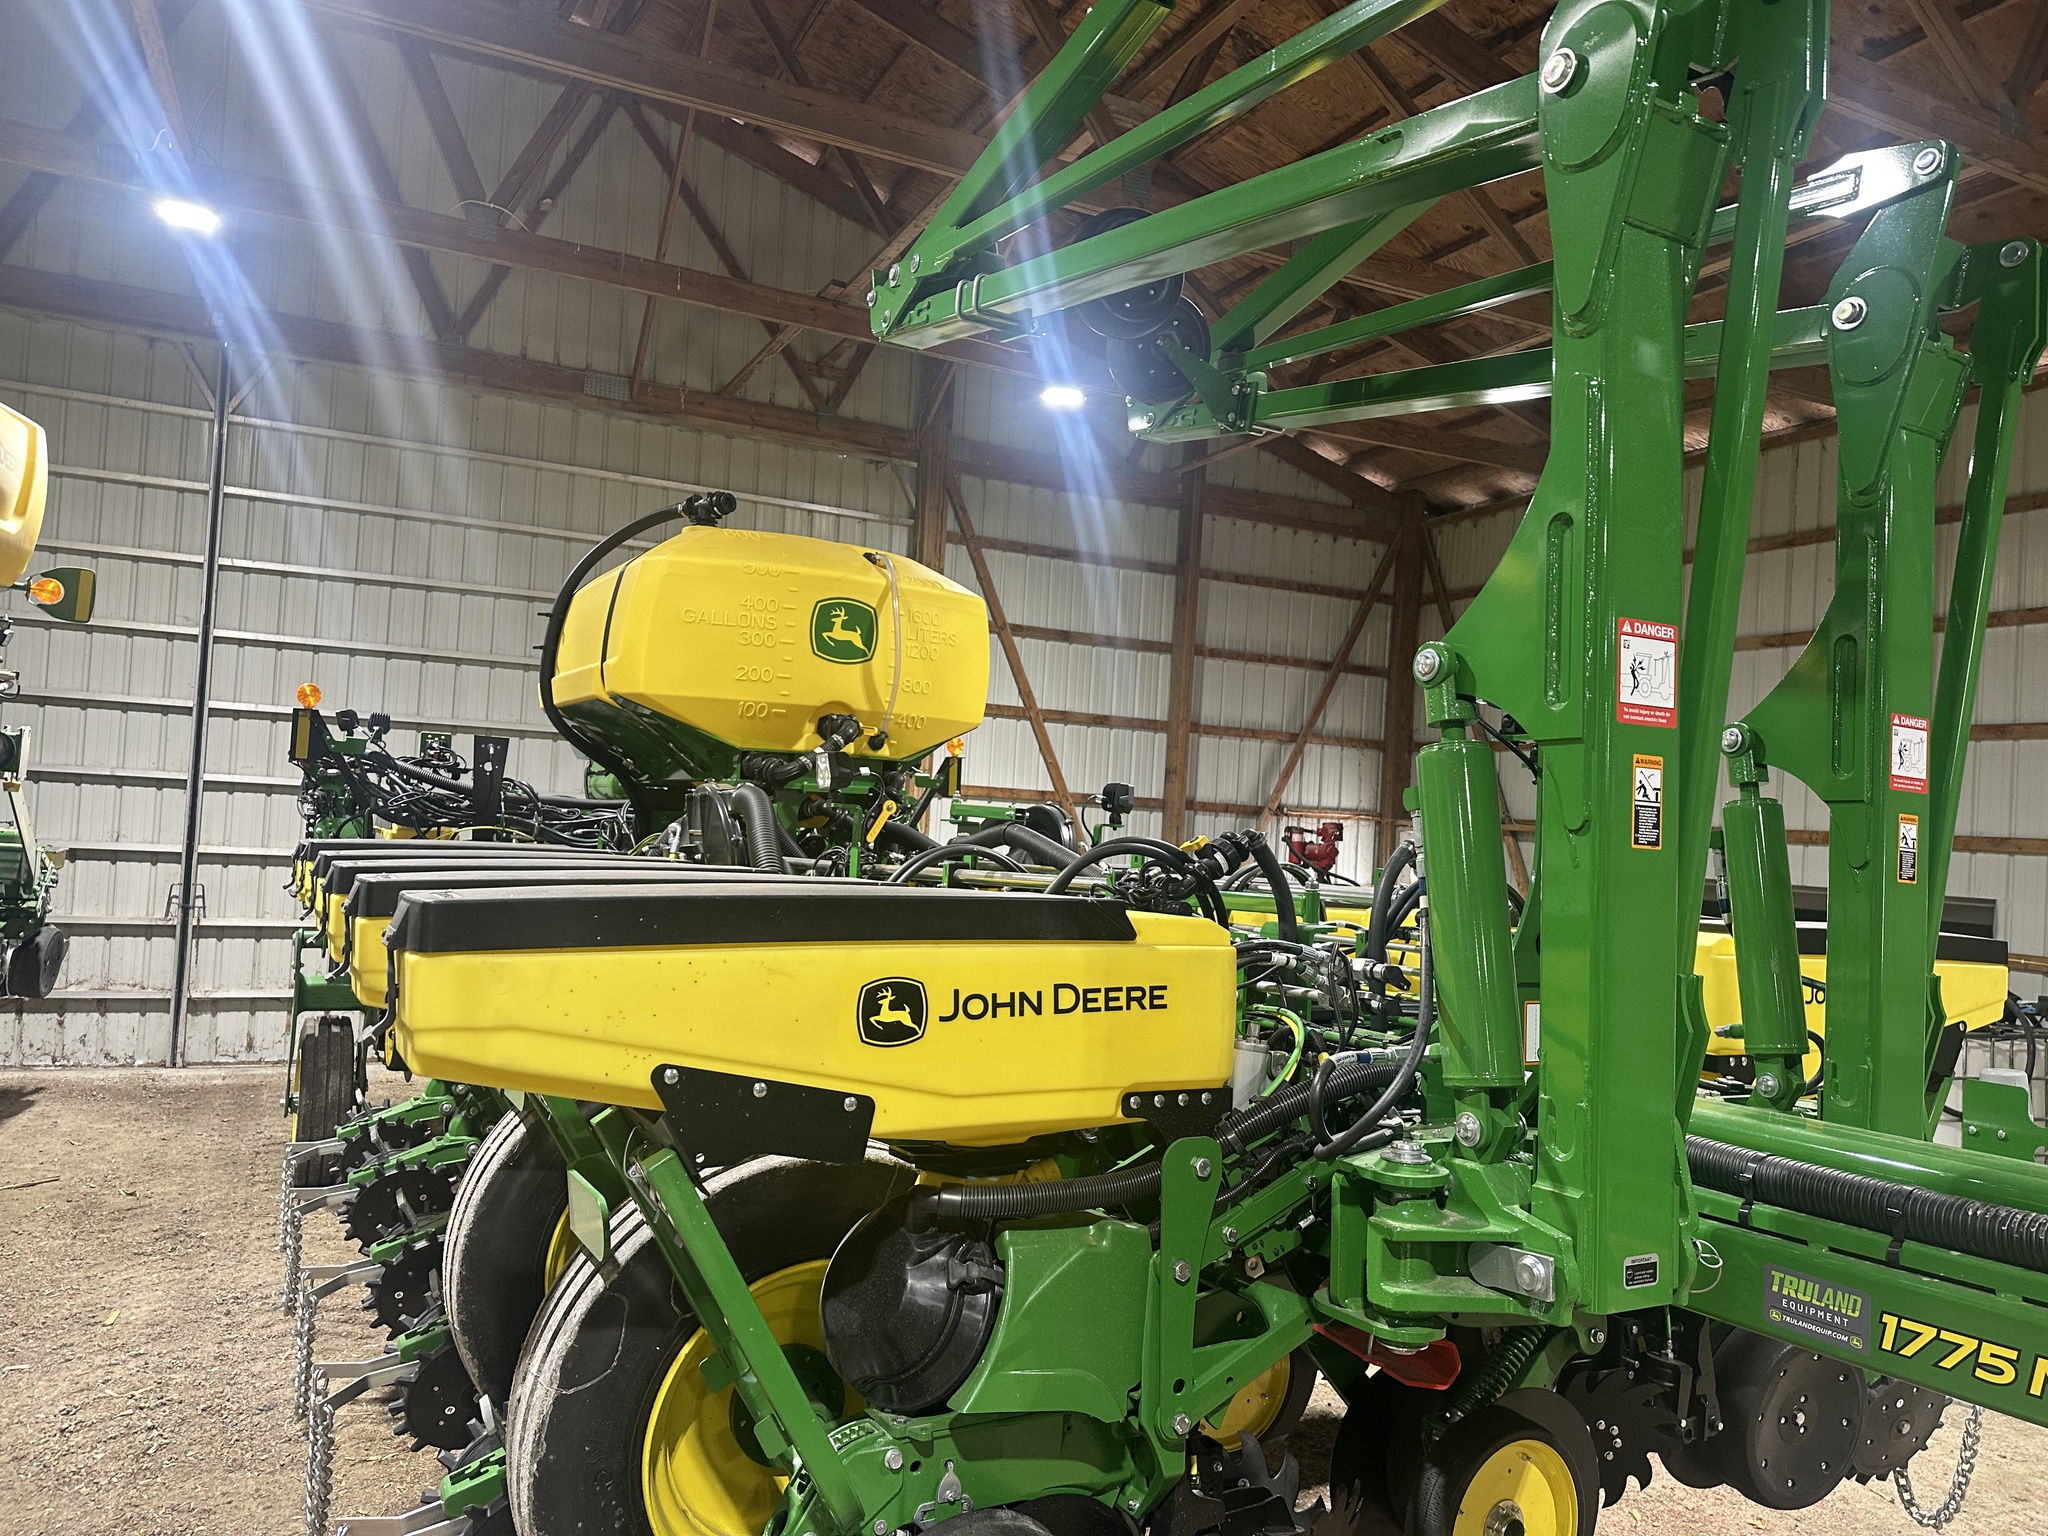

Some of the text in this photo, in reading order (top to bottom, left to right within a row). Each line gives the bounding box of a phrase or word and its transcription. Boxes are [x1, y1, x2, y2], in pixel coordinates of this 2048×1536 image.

[743, 560, 781, 577] 500
[740, 595, 779, 612] 400
[682, 608, 777, 630] GALLONS
[907, 609, 940, 625] 1600
[738, 630, 776, 647] 300
[905, 627, 958, 646] LITERS
[1634, 622, 1675, 639] DANGER
[905, 643, 940, 661] 1200
[735, 665, 773, 682] 200
[902, 678, 931, 694] 800
[737, 702, 769, 718] 100
[896, 714, 926, 730] 400
[1901, 717, 1927, 729] DANGER
[1640, 758, 1662, 767] WARNING
[939, 983, 1167, 1022] JOHN DEERE
[1805, 987, 1826, 1004] JO
[1631, 1256, 1652, 1264] IMPORTANT
[1771, 1270, 1862, 1317] TRULAND
[1782, 1298, 1849, 1326] EQUIPMENT
[1782, 1314, 1849, 1342] TRULANDEQUIP.COM
[1880, 1311, 2020, 1386] 1775
